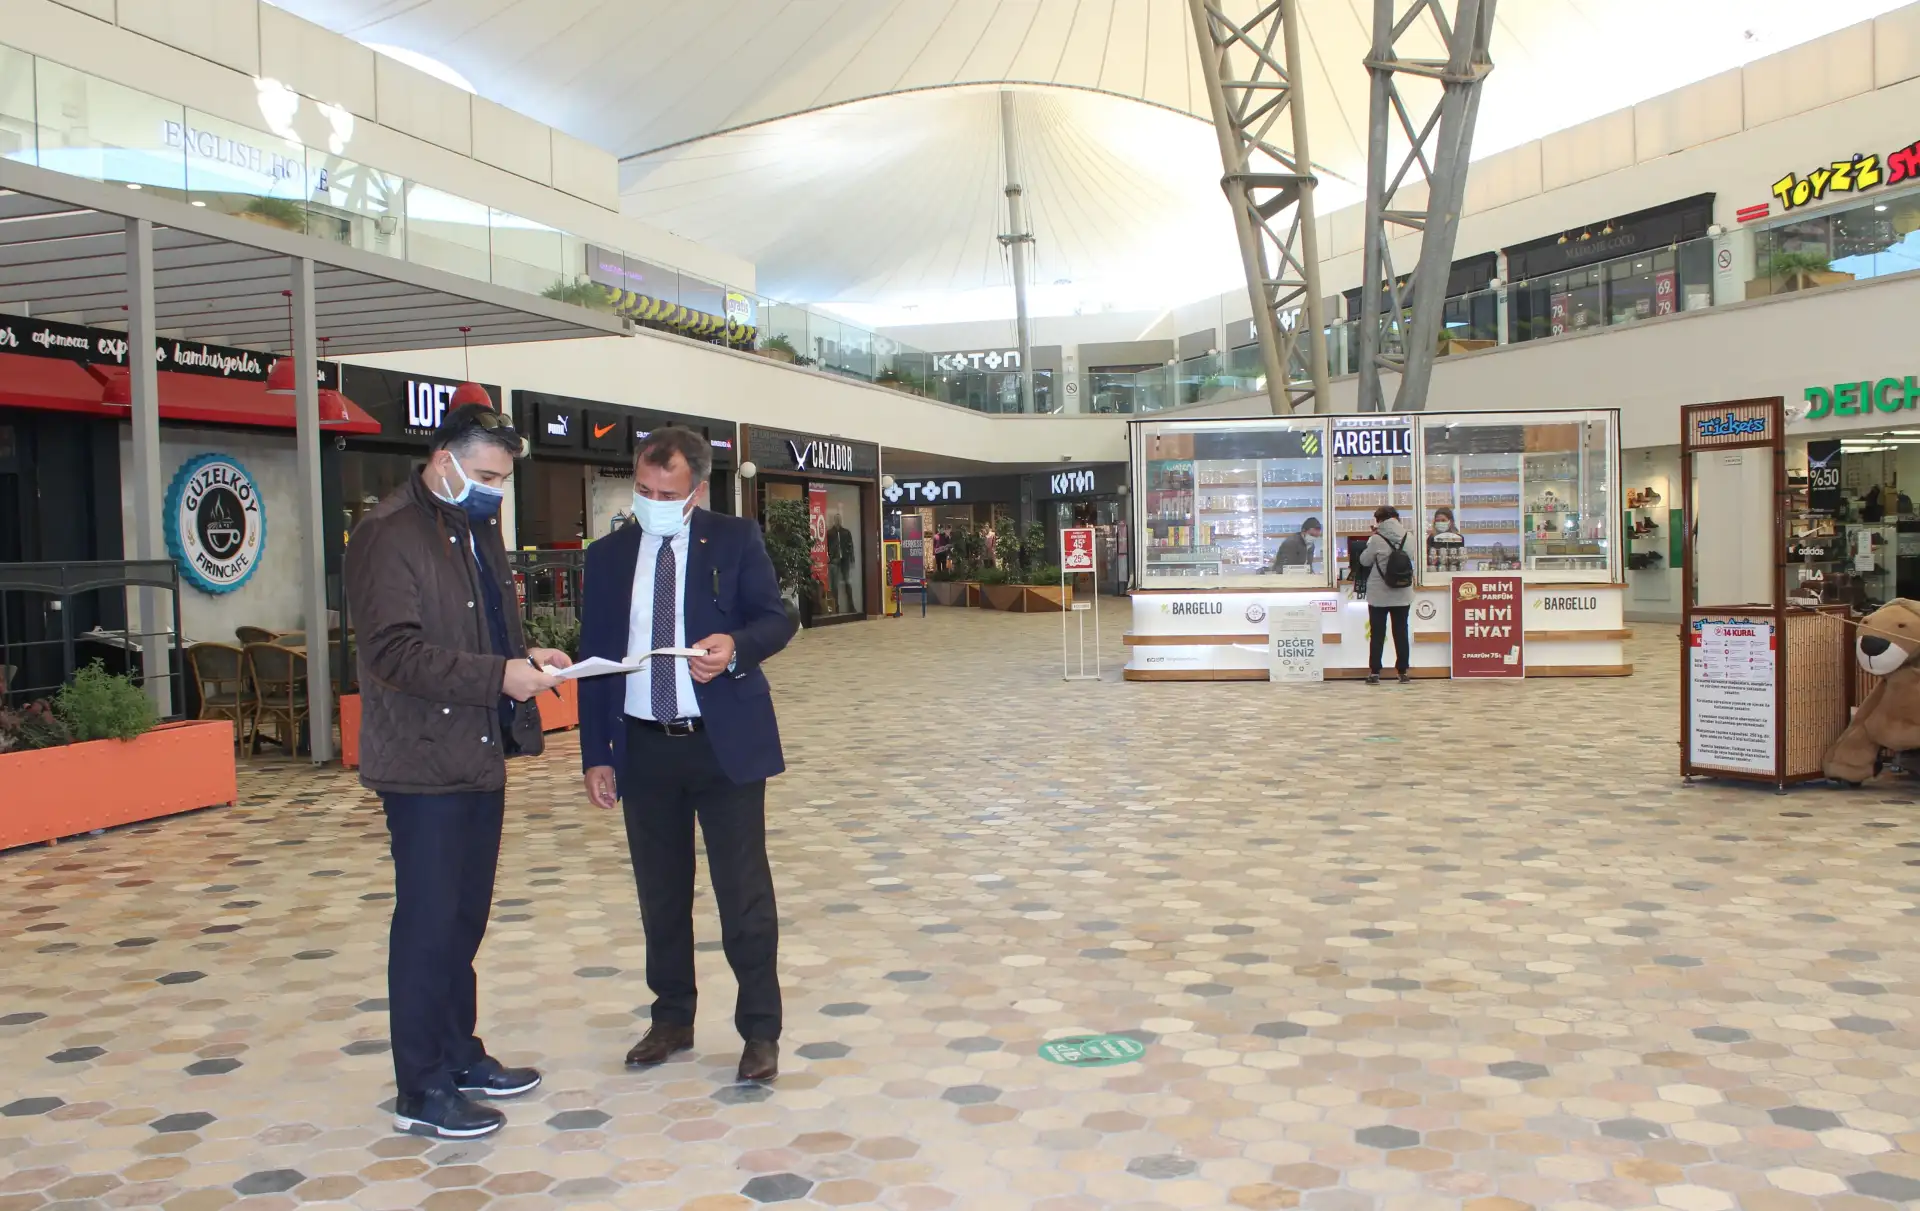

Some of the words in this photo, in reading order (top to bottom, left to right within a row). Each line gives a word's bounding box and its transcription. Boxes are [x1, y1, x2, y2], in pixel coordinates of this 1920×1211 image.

[174, 342, 261, 376] hamburgerler
[1698, 412, 1765, 437] Tickets
[812, 440, 853, 472] CAZADOR
[1051, 470, 1095, 495] KOTON
[1810, 468, 1839, 487] %50
[186, 468, 258, 513] GÜZELKÖY
[1798, 546, 1825, 556] adidas
[1797, 569, 1825, 581] FILA
[1481, 583, 1496, 592] EN
[1498, 581, 1513, 592] İYİ
[1481, 592, 1513, 600] PARFÜM
[1544, 596, 1597, 611] BARGELLO
[1172, 602, 1223, 615] BARGELLO
[1464, 608, 1486, 621] EN
[1489, 604, 1512, 621] İYİ
[1465, 622, 1512, 638] FİYAT
[1732, 629, 1756, 637] KURAL
[1277, 637, 1314, 648] DEĞER
[1277, 648, 1315, 658] LİSİNİZ
